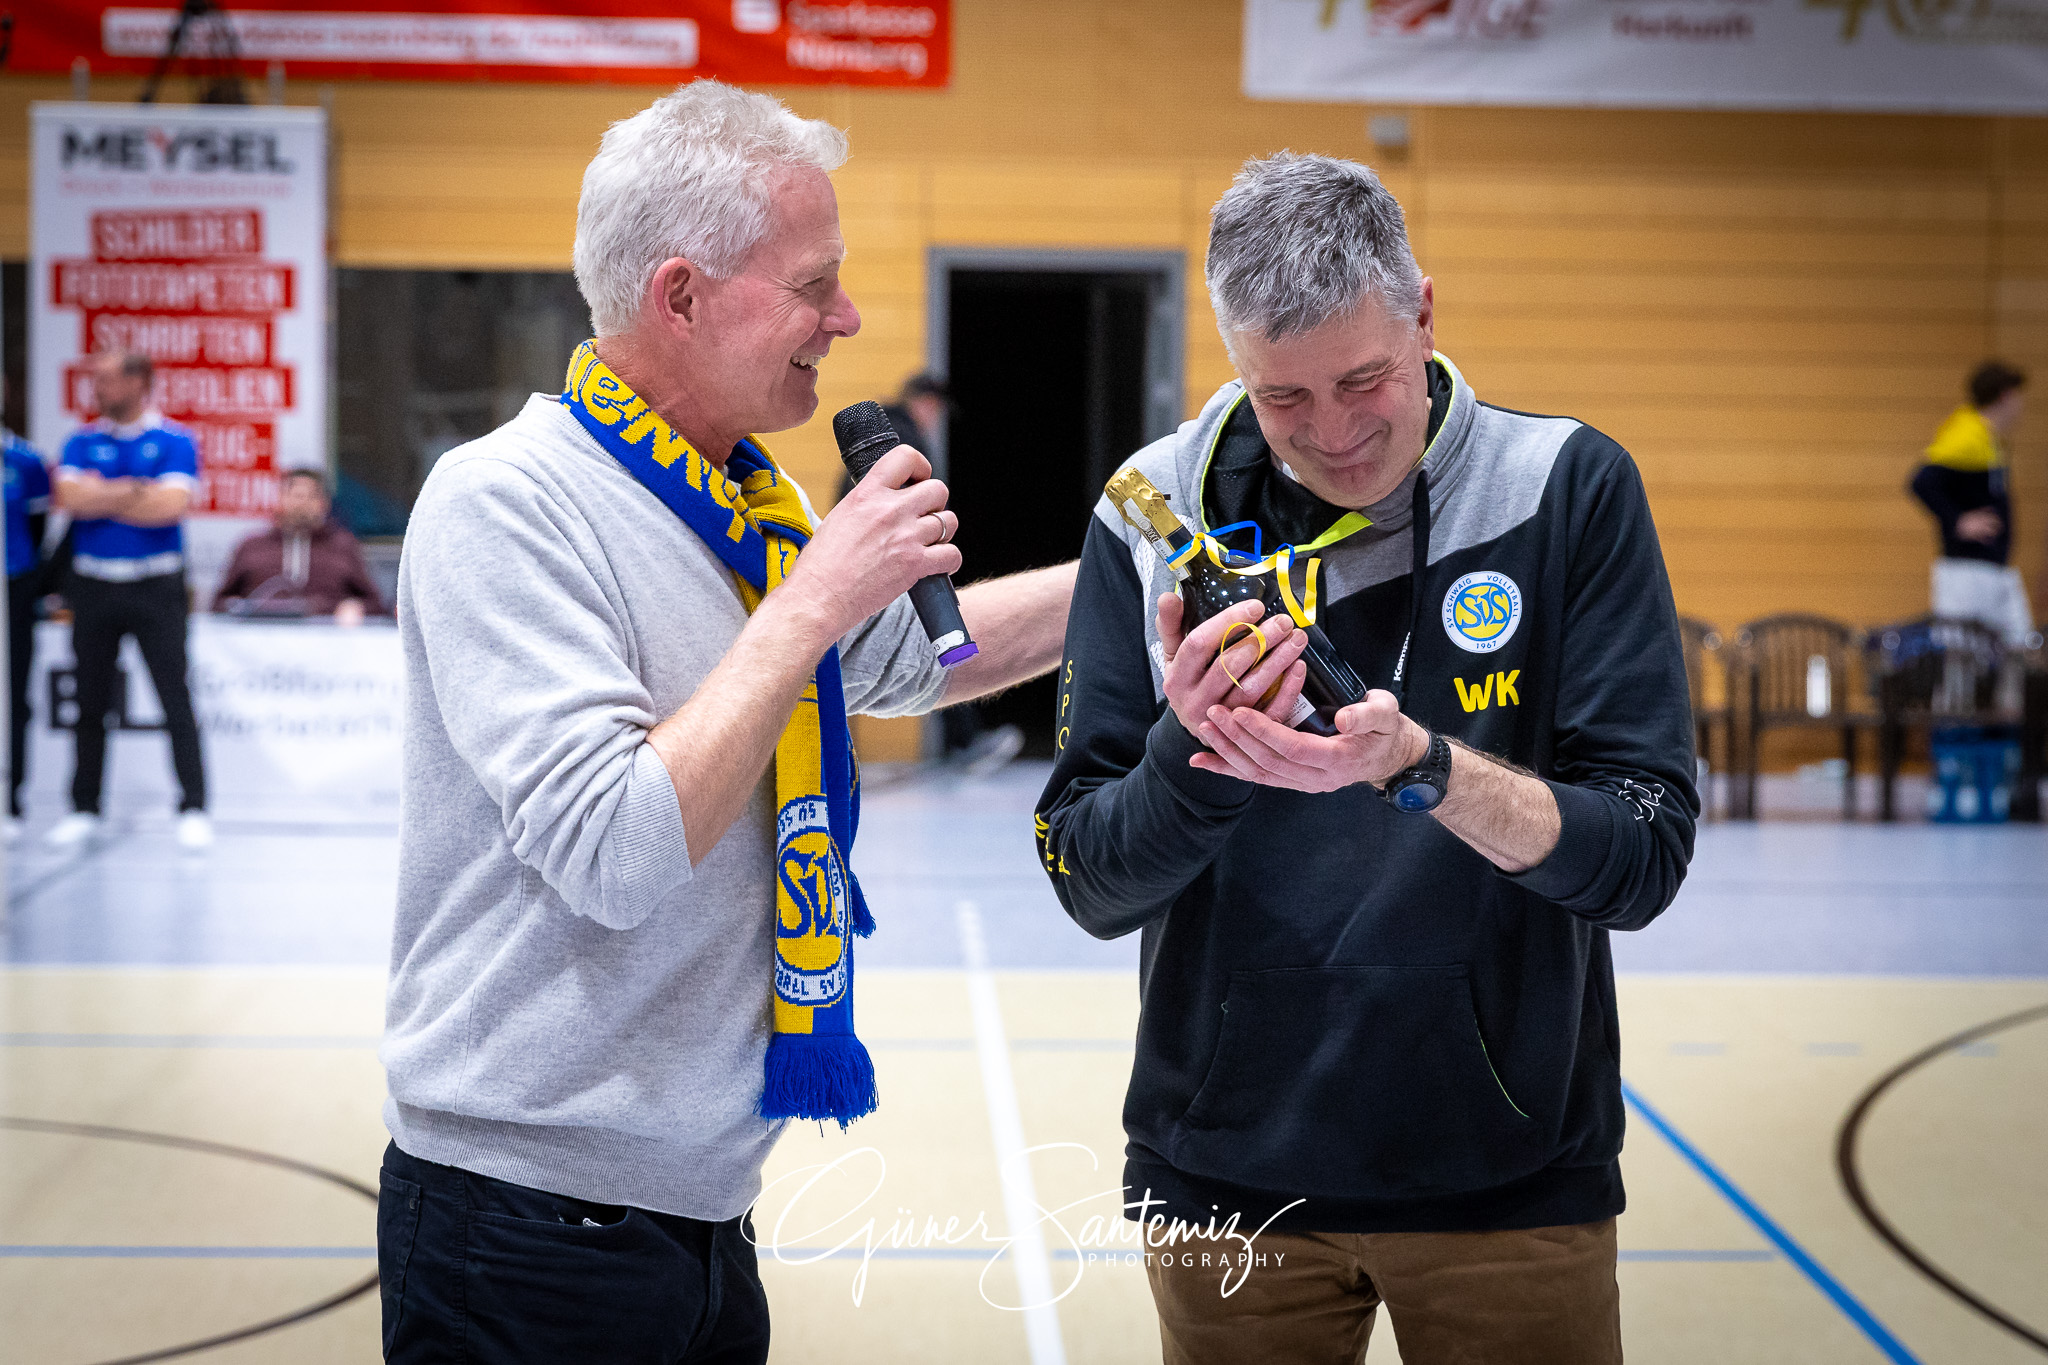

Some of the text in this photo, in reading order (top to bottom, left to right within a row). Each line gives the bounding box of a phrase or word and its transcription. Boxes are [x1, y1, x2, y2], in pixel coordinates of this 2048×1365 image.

[61, 126, 296, 174] MEYSEL
[101, 218, 253, 252] SCHILDER
[60, 268, 285, 308] FOTOTAPETEN
[92, 318, 266, 362] SCHRIFTEN
[1446, 575, 1518, 628] SV SCHWAIG VOLLEYBALL
[1476, 640, 1497, 649] 1967
[1058, 659, 1074, 750] SPO
[1453, 669, 1521, 713] WK
